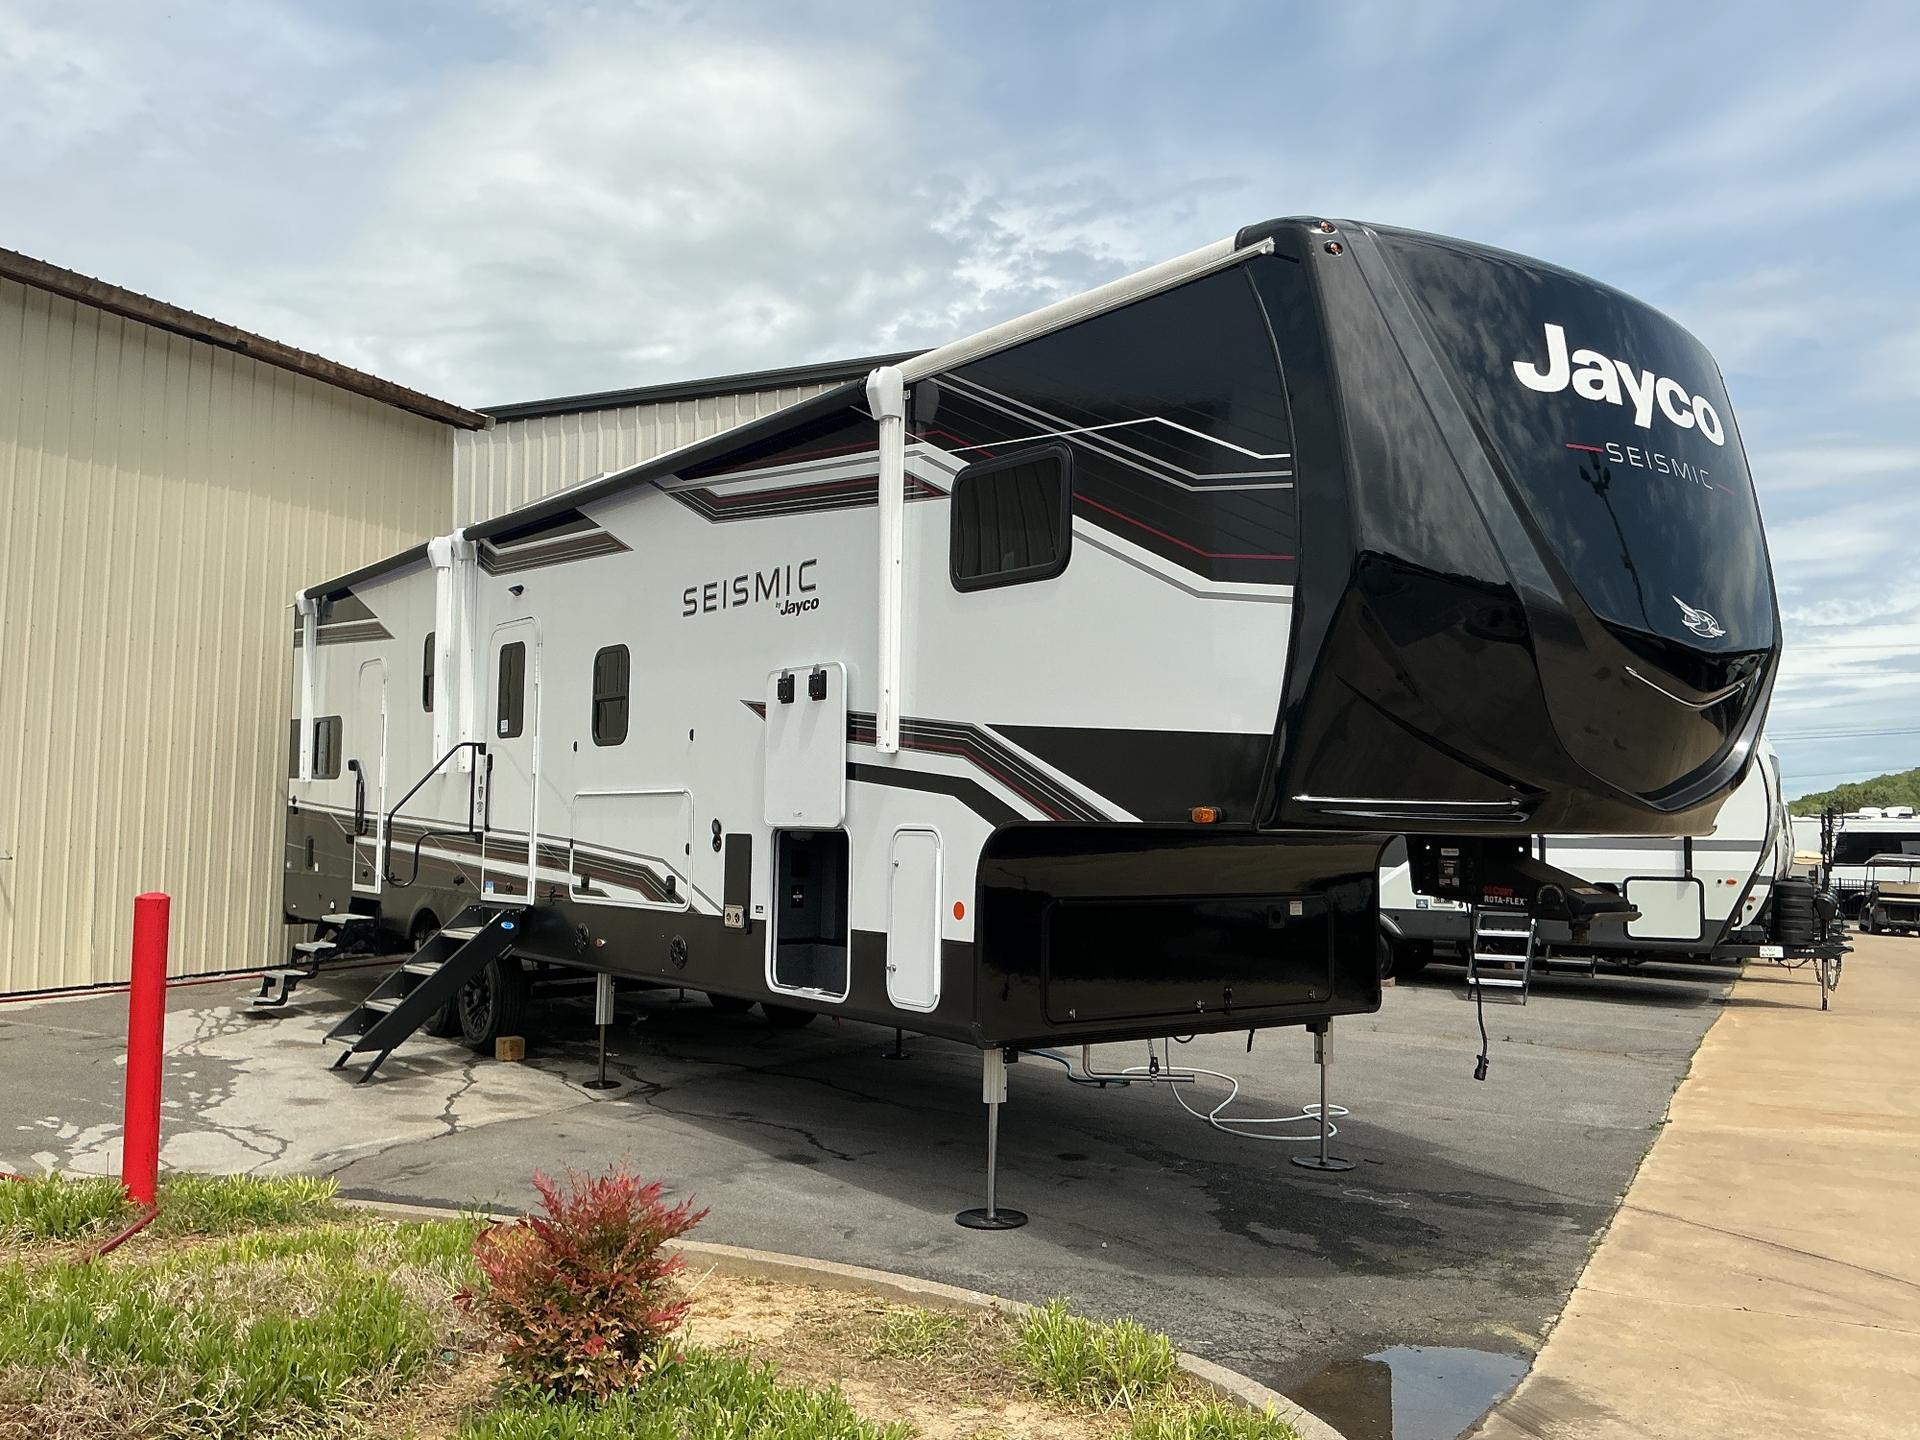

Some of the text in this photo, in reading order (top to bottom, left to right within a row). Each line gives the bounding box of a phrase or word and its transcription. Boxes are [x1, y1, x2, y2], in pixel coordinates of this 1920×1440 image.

[1512, 323, 1725, 446] Jayco
[1605, 442, 1713, 491] SEISMIC
[682, 558, 818, 617] SEISMIC
[780, 598, 820, 616] Jayco
